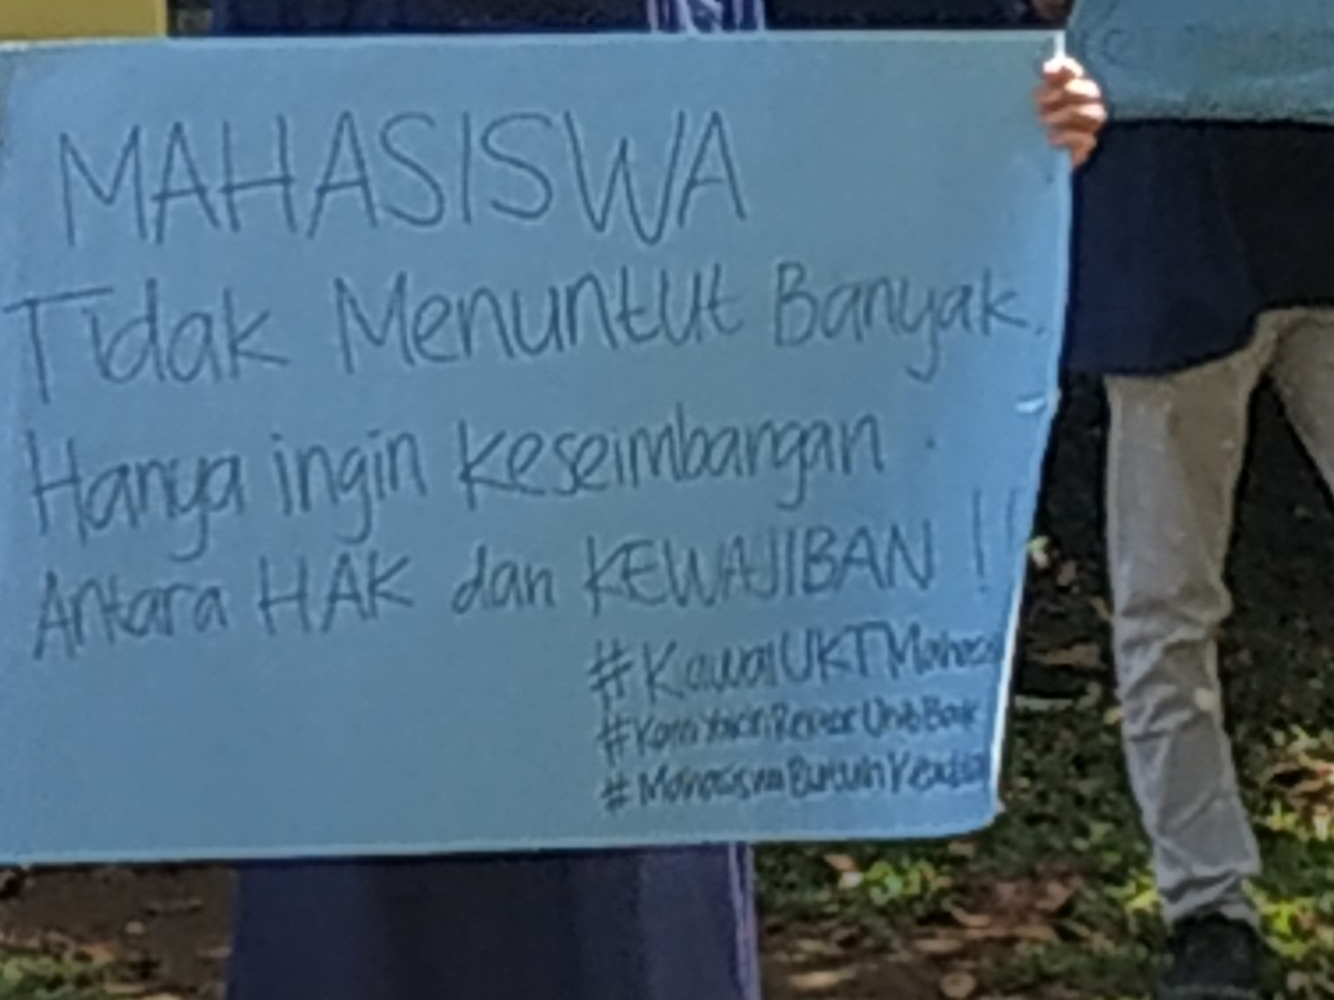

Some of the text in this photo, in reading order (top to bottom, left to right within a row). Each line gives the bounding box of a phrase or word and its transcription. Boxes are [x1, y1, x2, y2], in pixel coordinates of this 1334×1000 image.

[60, 110, 747, 247] MAHASISWA
[3, 277, 289, 404] Tidak
[333, 261, 744, 375] Menuntut
[28, 429, 246, 562] Hanya
[270, 429, 428, 546] ingin
[32, 570, 228, 660] Antara
[257, 550, 415, 635] HAK
[452, 544, 555, 615] dan
[582, 515, 934, 617] KEWAJIBAN
